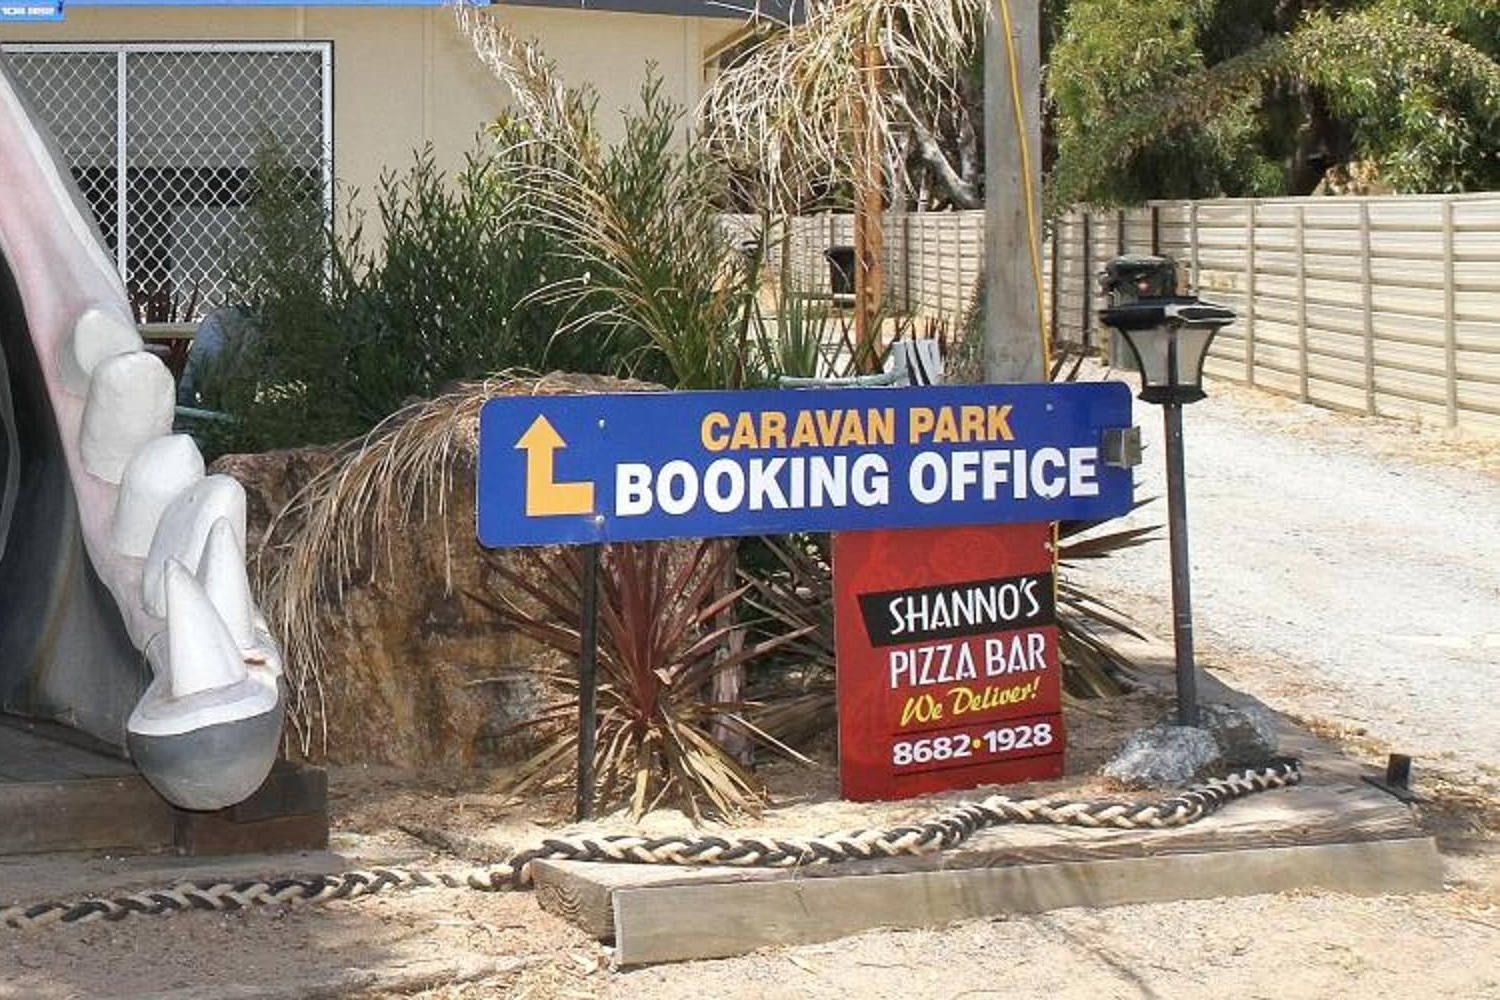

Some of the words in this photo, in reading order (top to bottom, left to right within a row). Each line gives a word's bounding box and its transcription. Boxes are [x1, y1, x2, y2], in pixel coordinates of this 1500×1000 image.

[701, 408, 895, 451] CARAVAN
[909, 405, 1015, 444] PARK
[615, 456, 889, 518] BOOKING
[908, 446, 1099, 502] OFFICE
[889, 578, 1041, 635] SHANNO'S
[890, 641, 977, 689] PIZZA
[985, 633, 1047, 677] BAR
[900, 694, 943, 728] We
[947, 676, 1041, 716] Deliver!
